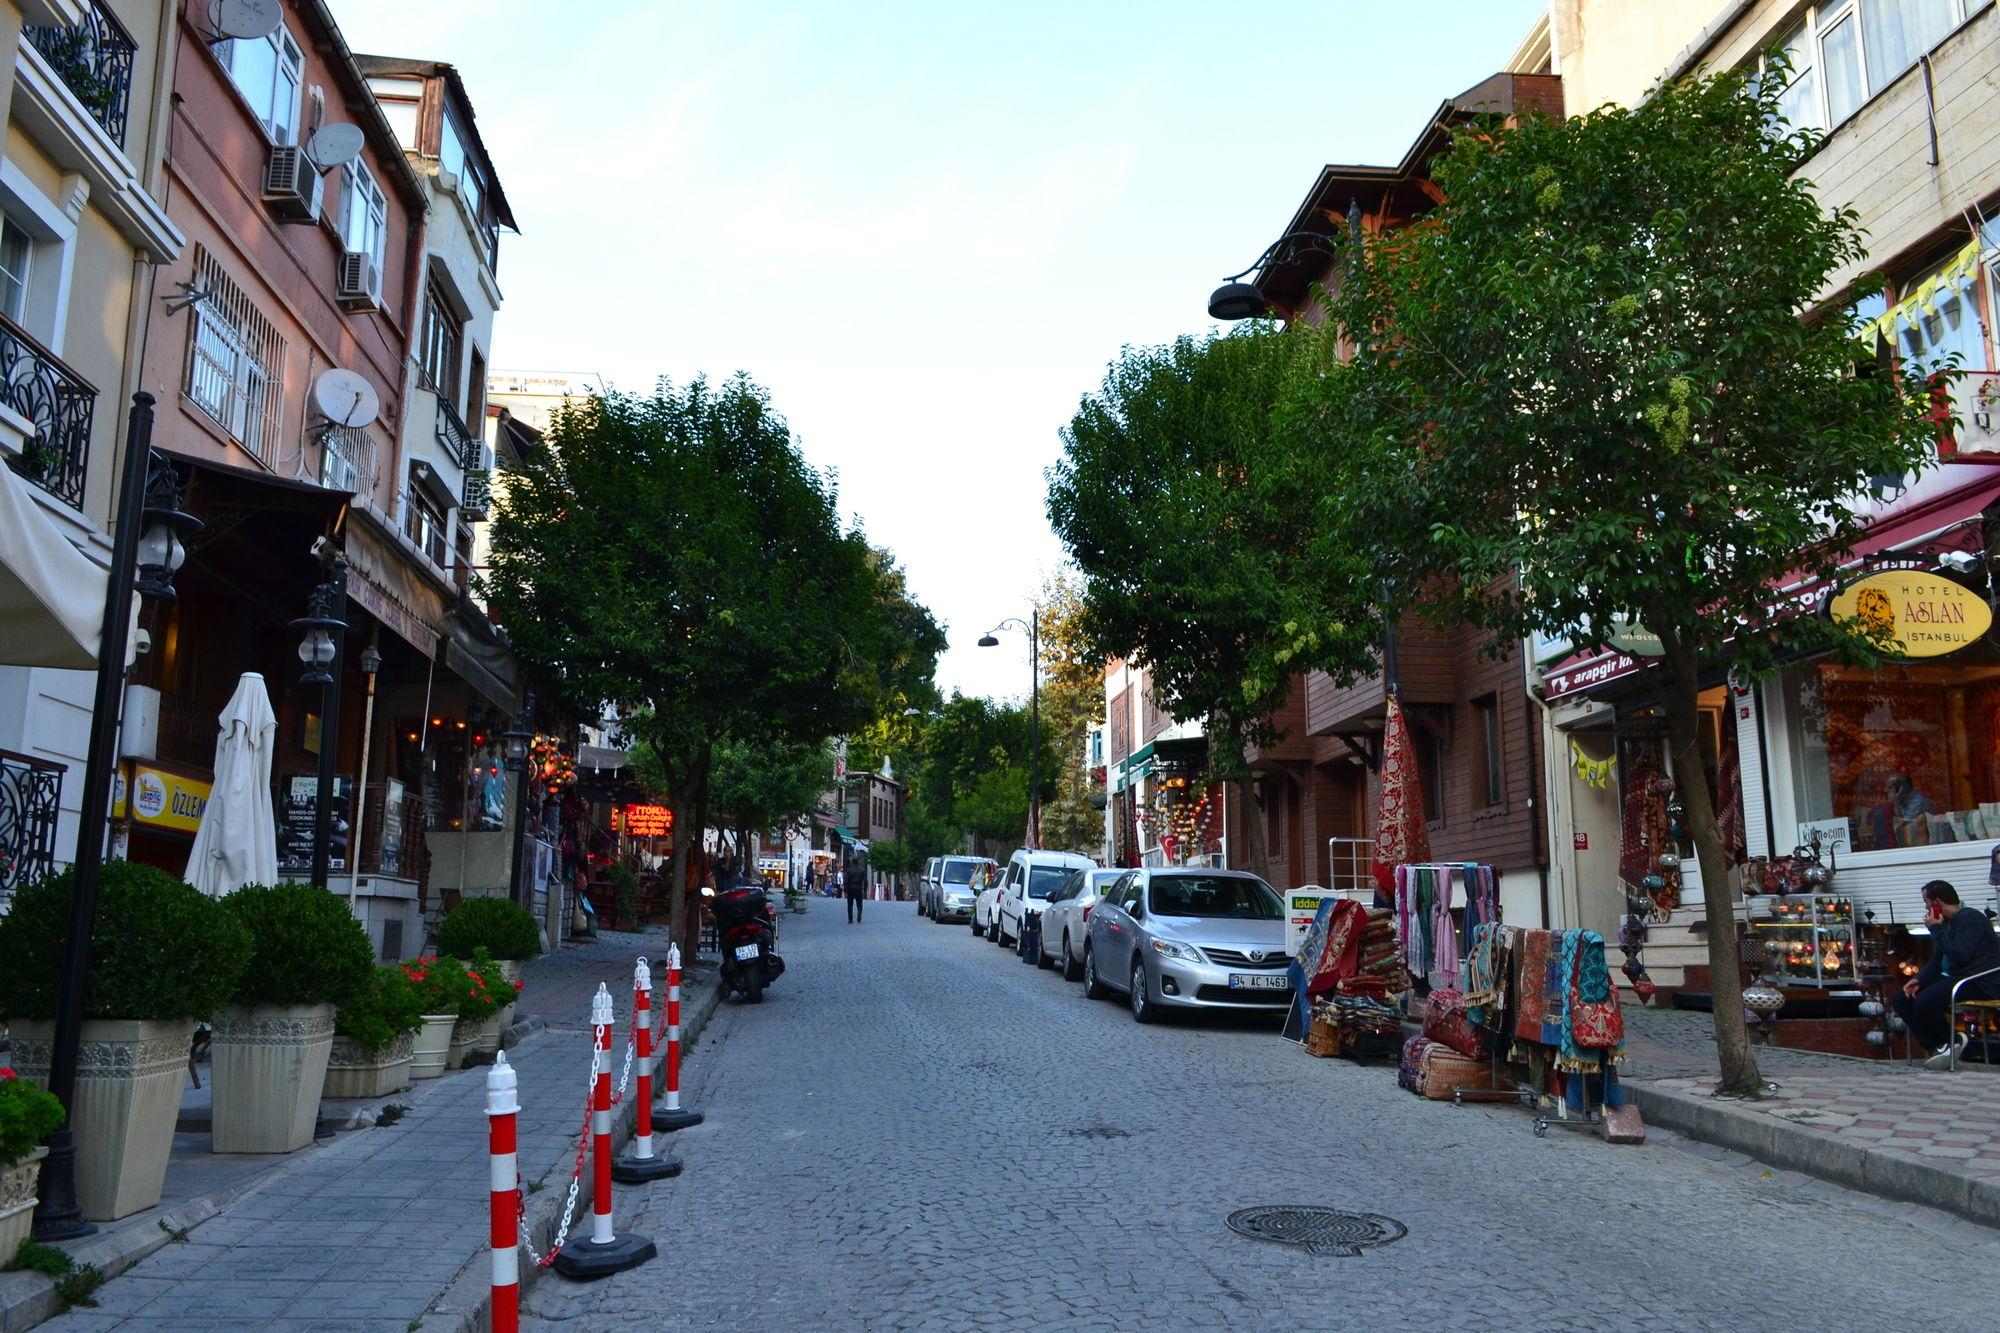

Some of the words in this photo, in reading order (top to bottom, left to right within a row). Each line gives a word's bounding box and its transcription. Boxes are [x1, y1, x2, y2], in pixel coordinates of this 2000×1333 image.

[1902, 585, 1963, 597] HOTEL
[1904, 602, 1965, 624] ASLAN
[1906, 631, 1968, 643] ISTANBUL
[1573, 659, 1617, 684] arapgir
[1234, 976, 1245, 986] 34
[1250, 976, 1261, 986] AC
[1265, 977, 1286, 988] 1463
